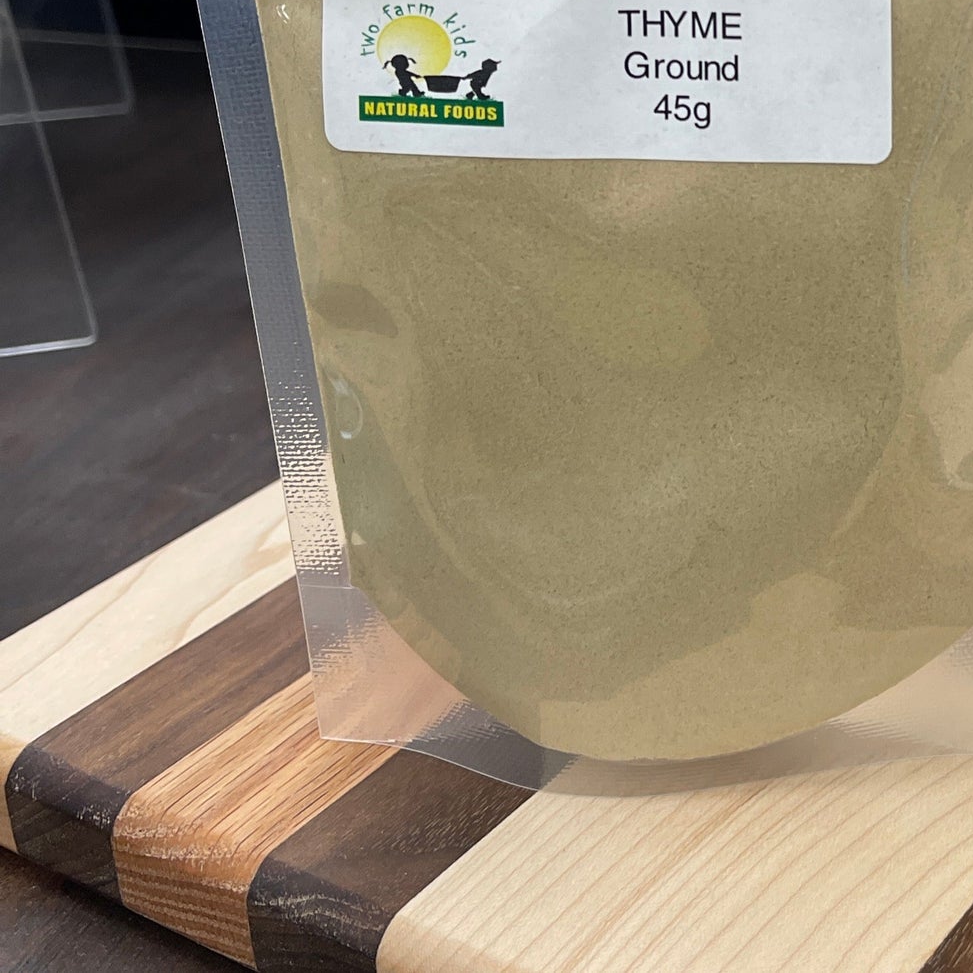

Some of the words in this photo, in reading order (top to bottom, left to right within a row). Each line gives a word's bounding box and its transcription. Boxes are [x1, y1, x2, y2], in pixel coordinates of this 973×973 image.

[360, 24, 379, 57] two
[382, 3, 435, 20] farm
[443, 12, 476, 58] kids
[618, 9, 742, 40] THYME
[624, 51, 739, 81] Ground
[364, 101, 438, 118] NATURAL
[444, 105, 498, 121] FOODS
[653, 94, 711, 129] 45g
